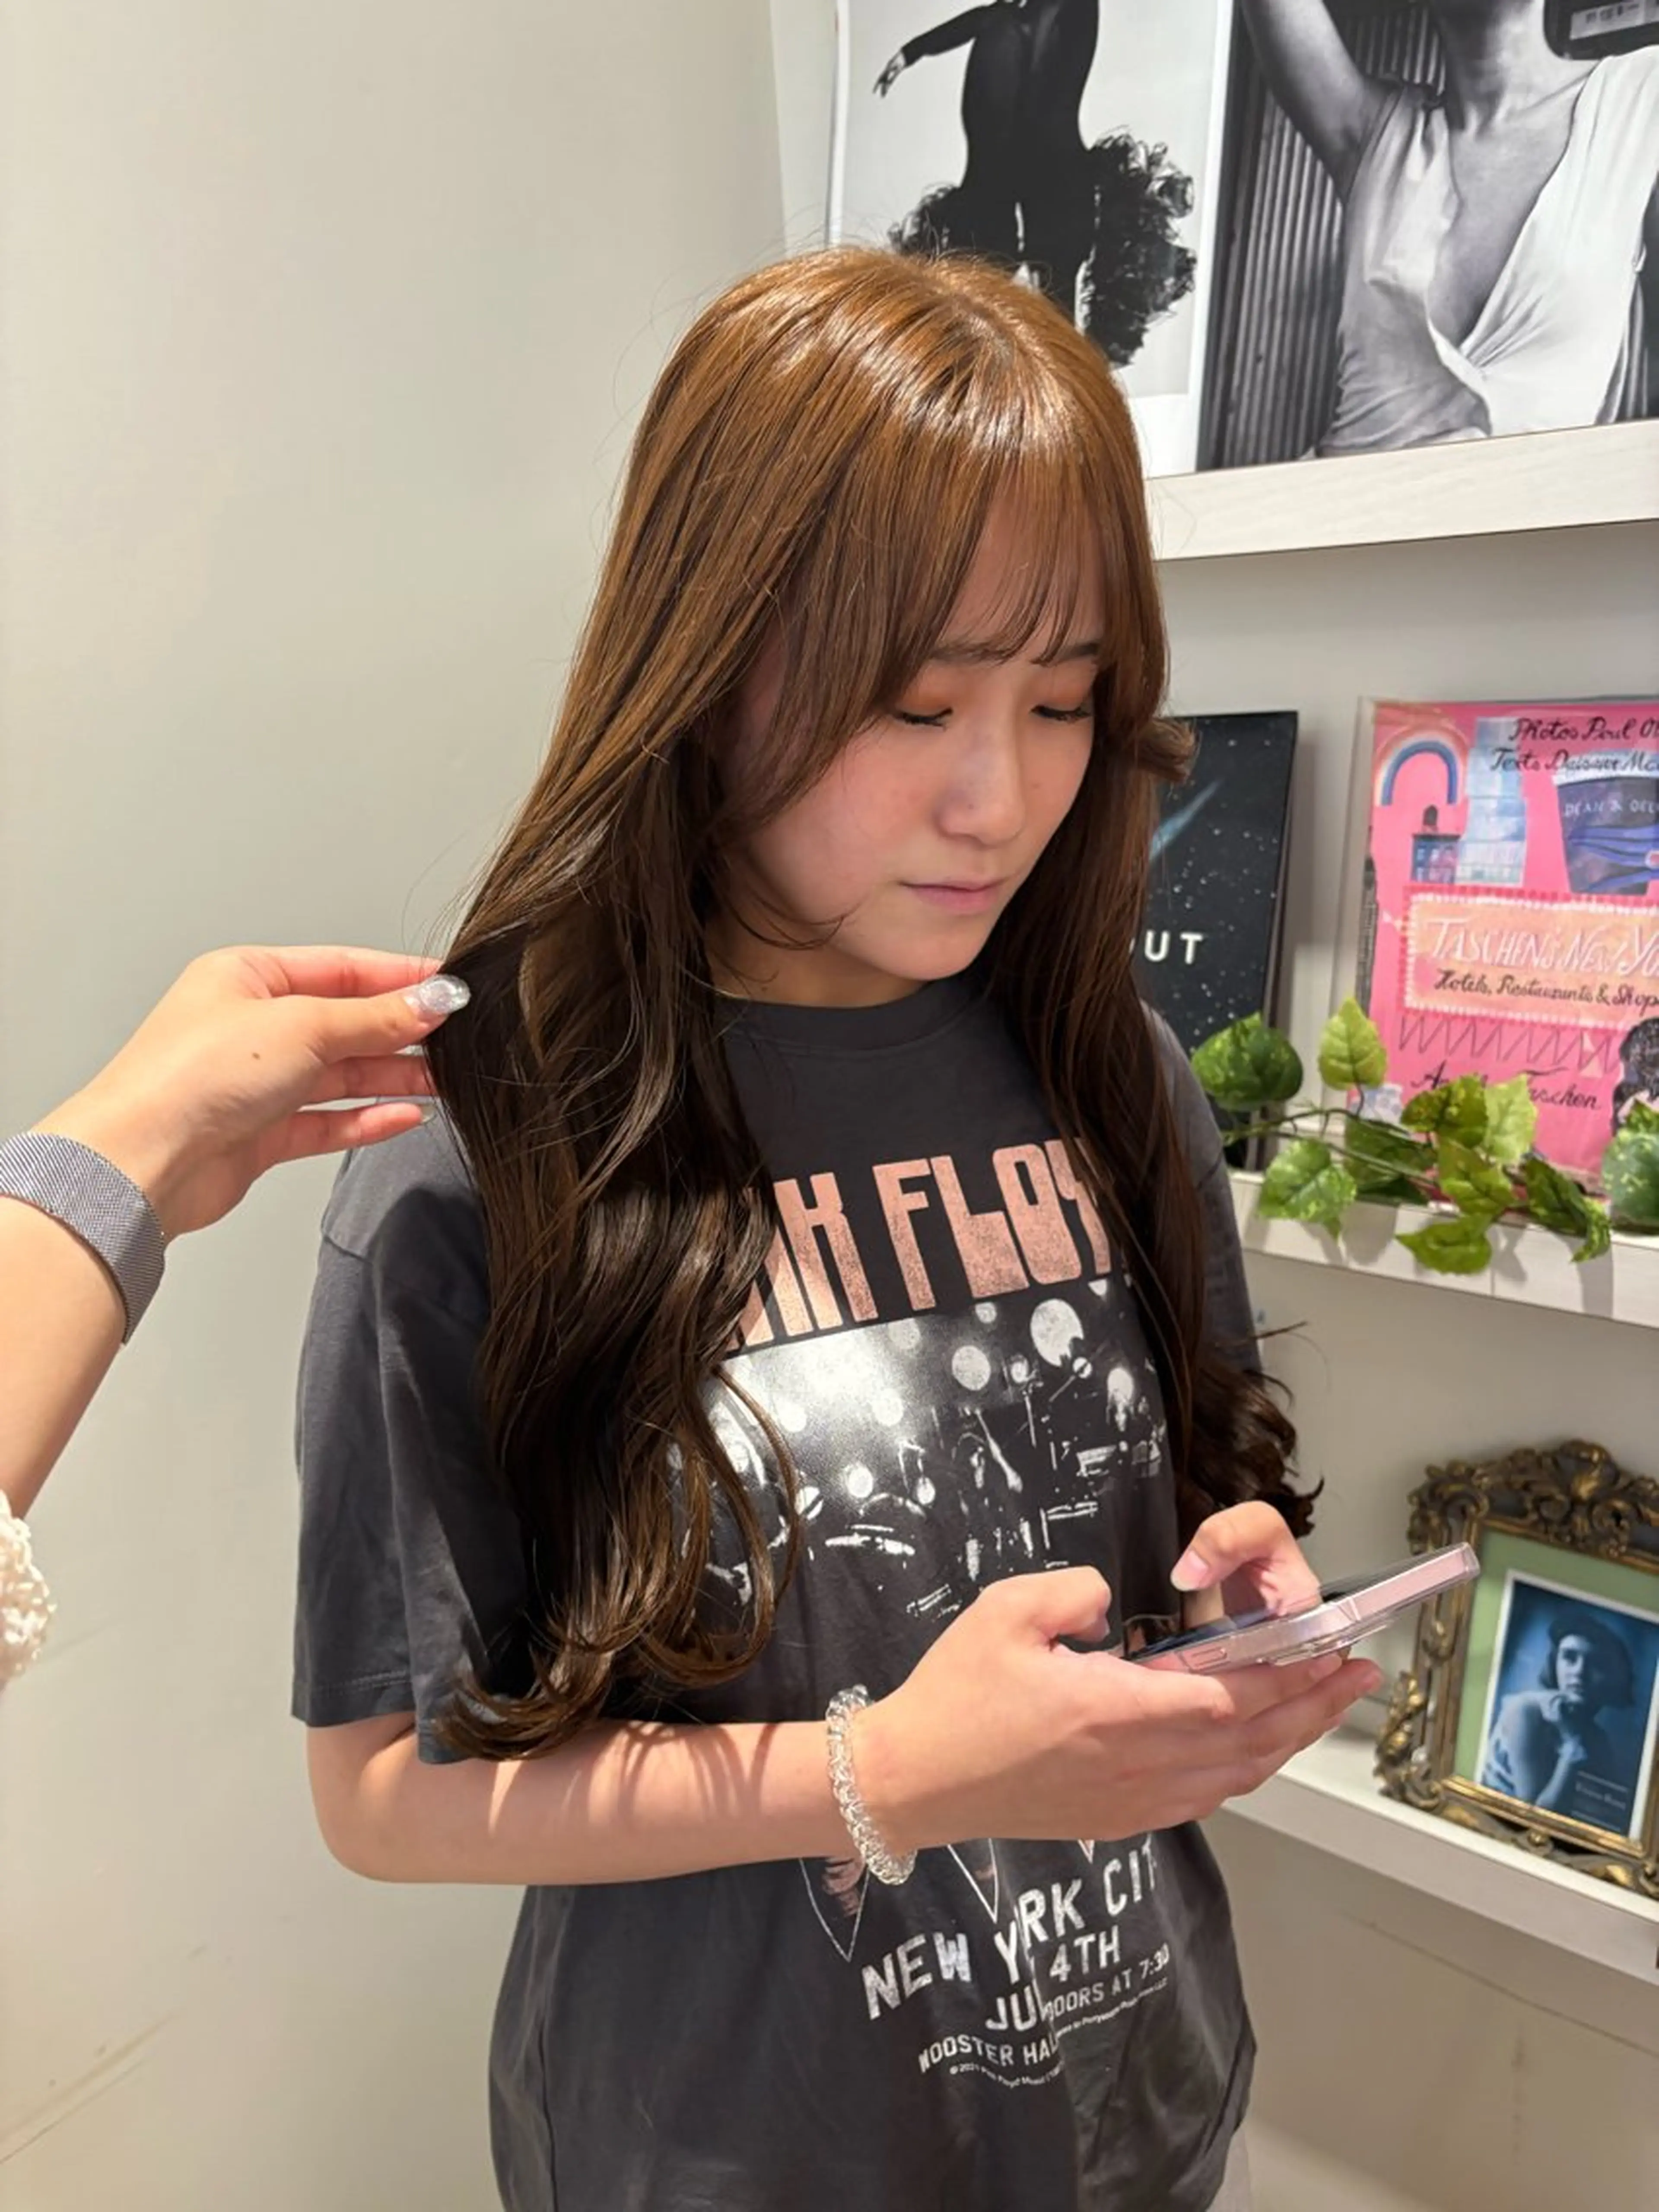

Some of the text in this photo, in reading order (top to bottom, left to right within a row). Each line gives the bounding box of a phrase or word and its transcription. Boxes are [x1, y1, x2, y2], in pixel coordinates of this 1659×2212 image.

[1508, 717, 1578, 741] Photos
[1129, 929, 1203, 965] UT
[1595, 985, 1610, 1006] &
[872, 1138, 1112, 1311] FLOY
[862, 1932, 972, 2020] NEW
[994, 1878, 1085, 1984] YRK
[1049, 1925, 1121, 1983] 4TH
[1112, 1968, 1132, 1996] AT
